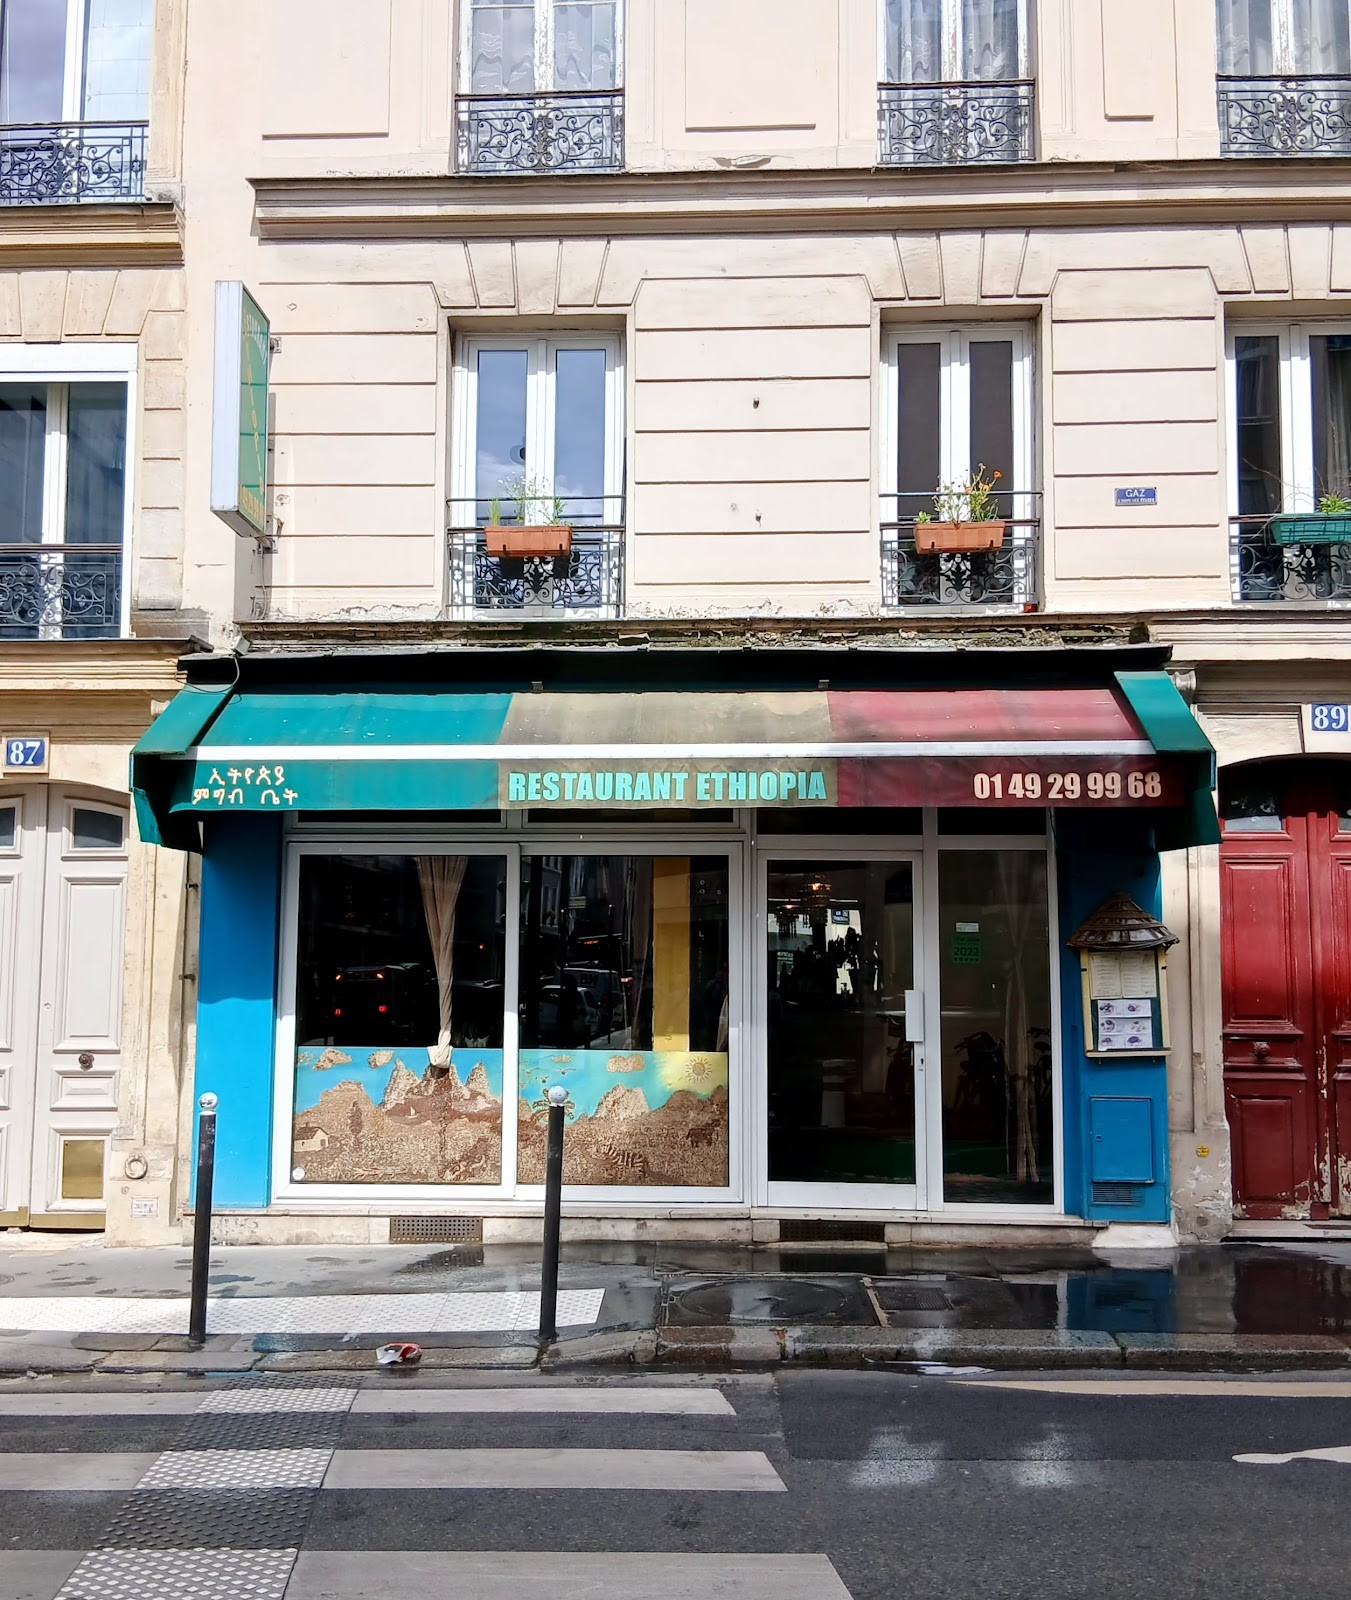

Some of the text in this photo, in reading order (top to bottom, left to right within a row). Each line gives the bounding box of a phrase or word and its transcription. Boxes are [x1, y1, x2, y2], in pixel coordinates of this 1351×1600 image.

[1125, 489, 1146, 498] GAZ
[1314, 706, 1346, 729] 89
[10, 741, 41, 765] 87
[208, 765, 285, 786] ኢትዮጵያ
[508, 770, 827, 801] RESTAURANT ETHIOPIA
[973, 771, 1162, 799] 01 49 29 99 68
[192, 788, 298, 806] ምግብ ቤት
[953, 946, 979, 957] 2022
